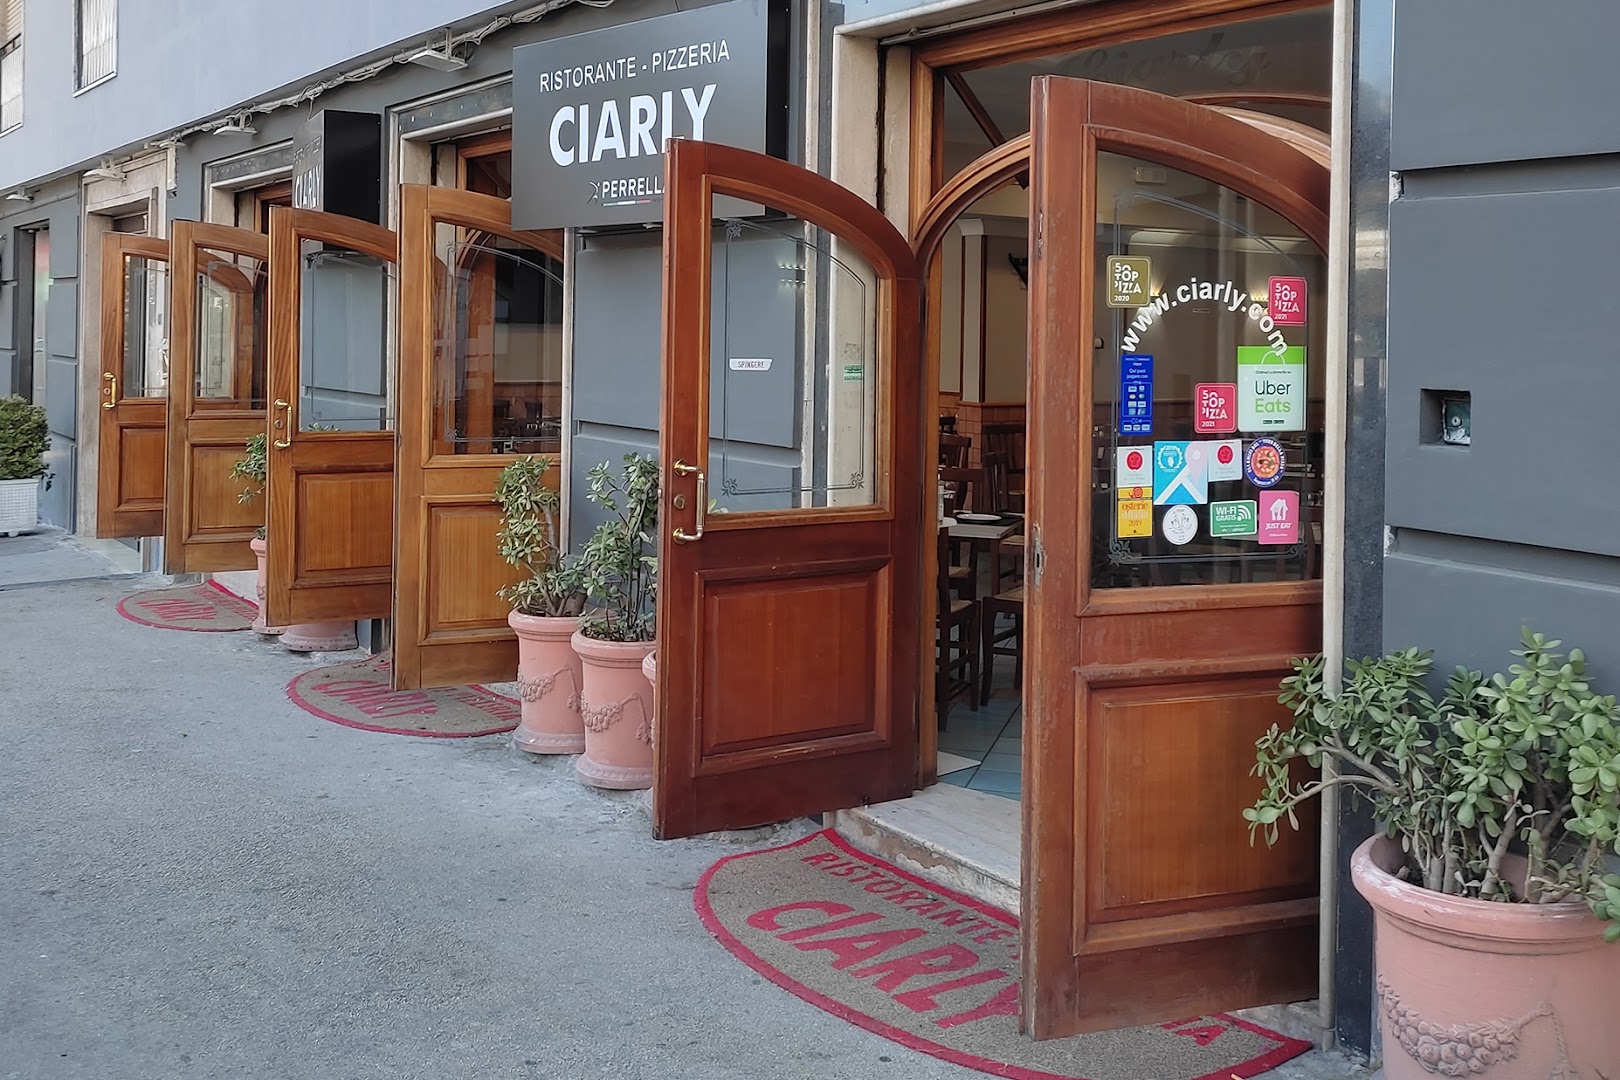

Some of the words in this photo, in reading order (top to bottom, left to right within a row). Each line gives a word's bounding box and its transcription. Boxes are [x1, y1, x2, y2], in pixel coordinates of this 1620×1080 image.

[540, 56, 637, 93] RISTORANTE
[652, 39, 731, 74] PIZZERIA
[549, 83, 718, 168] CIARLY
[602, 175, 665, 199] PERRELL
[1114, 270, 1139, 282] TOP
[1114, 281, 1142, 294] PIZZA
[1274, 291, 1298, 302] TOP
[1274, 301, 1300, 313] PIZZA
[1121, 276, 1289, 357] www.ciarly.com
[737, 360, 765, 369] SPINGERE
[1255, 380, 1292, 395] Uber
[1202, 398, 1226, 408] TOP
[1255, 398, 1291, 413] Eats
[1202, 407, 1228, 420] PIZZA
[1215, 505, 1237, 515] WI-FI
[1215, 514, 1237, 522] GRATIS
[1265, 522, 1281, 530] JUST
[801, 852, 1014, 945] RISTORANTE
[746, 899, 1021, 1029] CIARLY
